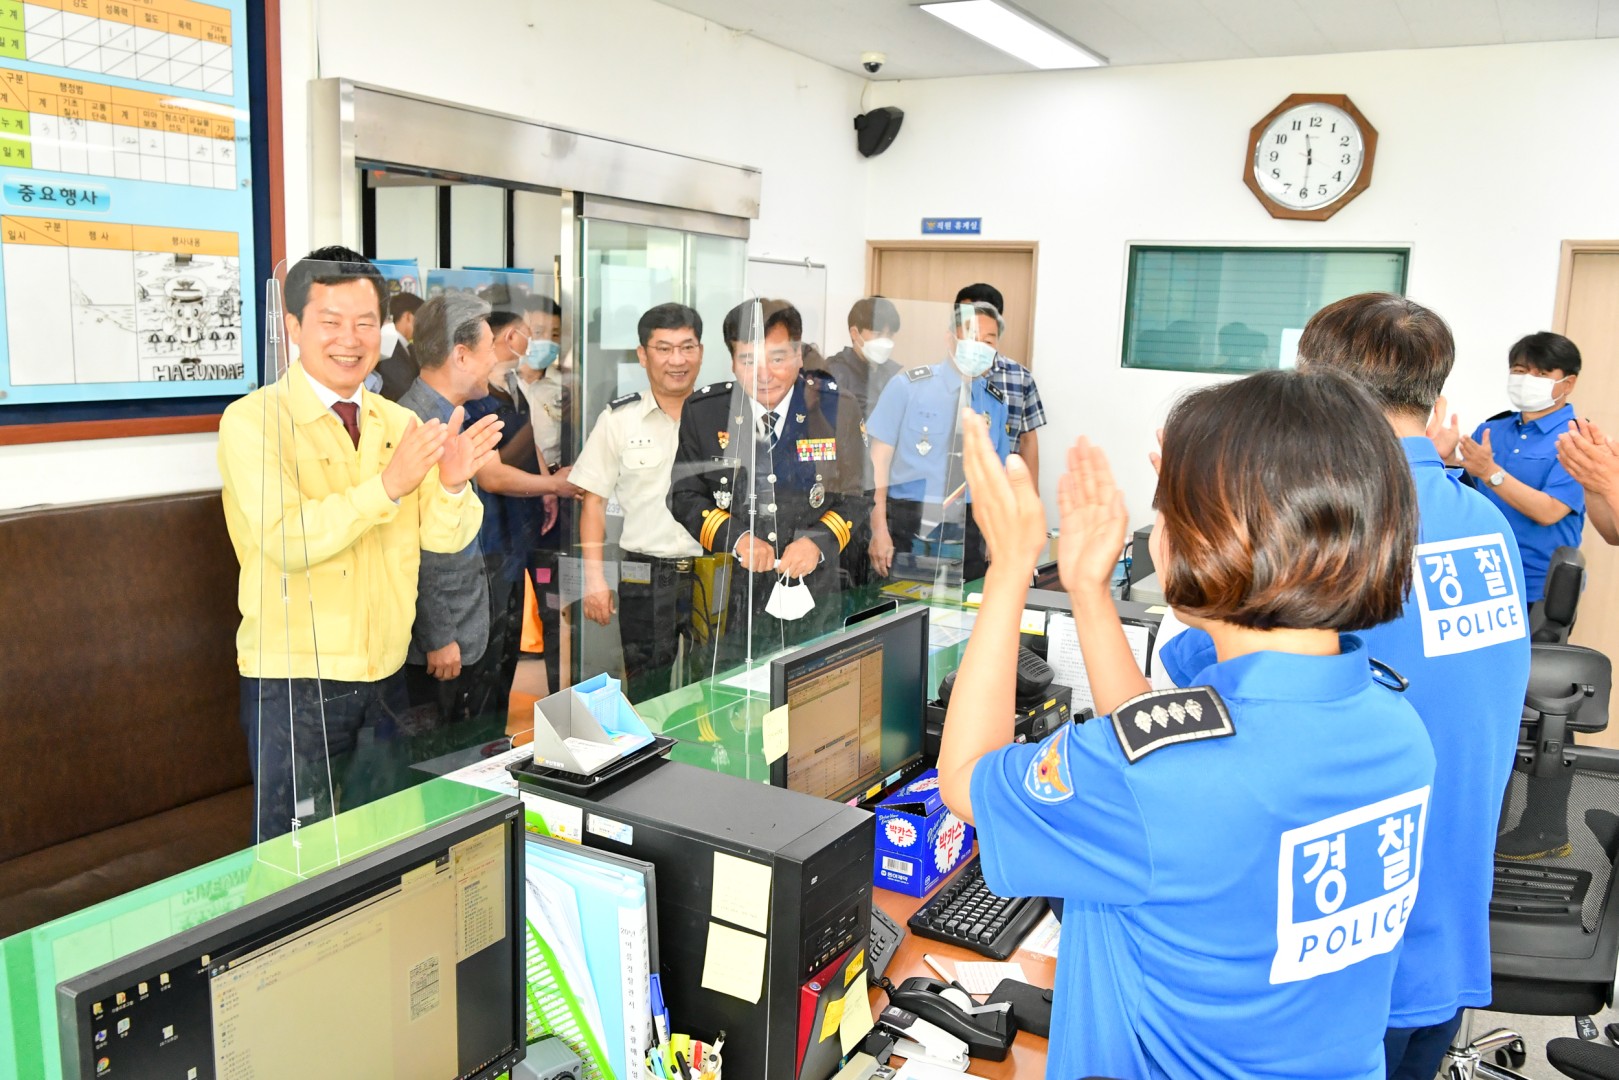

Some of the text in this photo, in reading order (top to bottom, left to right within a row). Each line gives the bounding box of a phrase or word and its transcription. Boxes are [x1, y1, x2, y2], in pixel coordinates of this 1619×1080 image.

[1292, 120, 1301, 131] 11
[1310, 116, 1322, 127] 12
[1331, 122, 1336, 133] 1
[1276, 134, 1287, 144] 10
[1340, 136, 1350, 147] 2
[1269, 151, 1279, 162] 9
[1341, 154, 1351, 164] 3
[1271, 168, 1280, 179] 8
[1332, 171, 1342, 182] 4
[1283, 183, 1292, 194] 7
[1299, 188, 1308, 199] 6
[1318, 184, 1327, 195] 5
[18, 184, 98, 206] 중요행사
[44, 222, 61, 232] 구분
[8, 230, 26, 241] 일시
[171, 236, 201, 248] 행사내용
[1438, 604, 1519, 642] POLICE
[889, 824, 913, 838] 박카스
[940, 820, 962, 850] 박카스
[947, 846, 954, 864] F
[1298, 894, 1411, 963] POLICE
